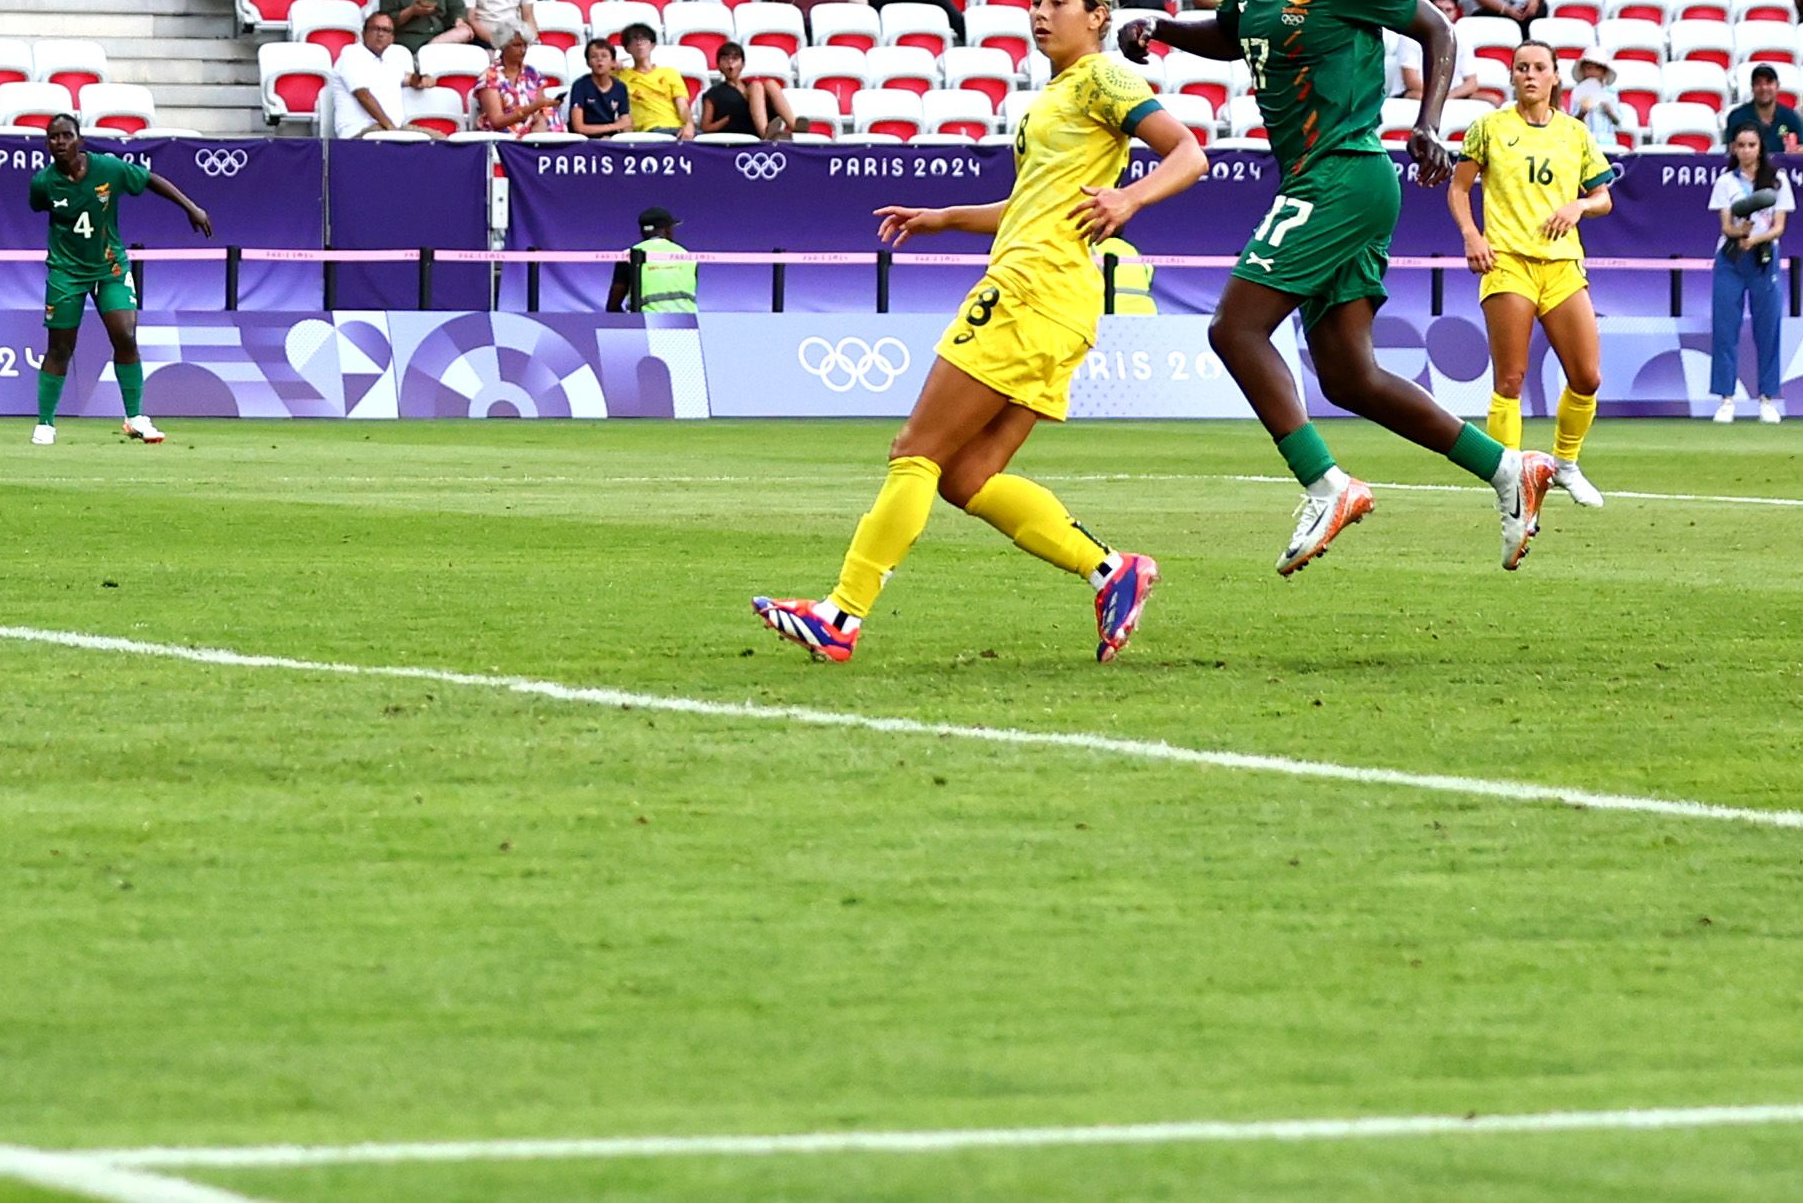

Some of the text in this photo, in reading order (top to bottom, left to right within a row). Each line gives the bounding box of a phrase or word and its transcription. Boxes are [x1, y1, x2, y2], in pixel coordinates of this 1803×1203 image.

[1016, 112, 1030, 155] 8
[623, 155, 692, 176] 2024
[913, 157, 981, 178] 2024
[1197, 160, 1262, 182] 024
[1525, 155, 1554, 186] 16
[72, 211, 95, 239] 4
[1253, 194, 1314, 248] 17
[966, 286, 1000, 327] 8
